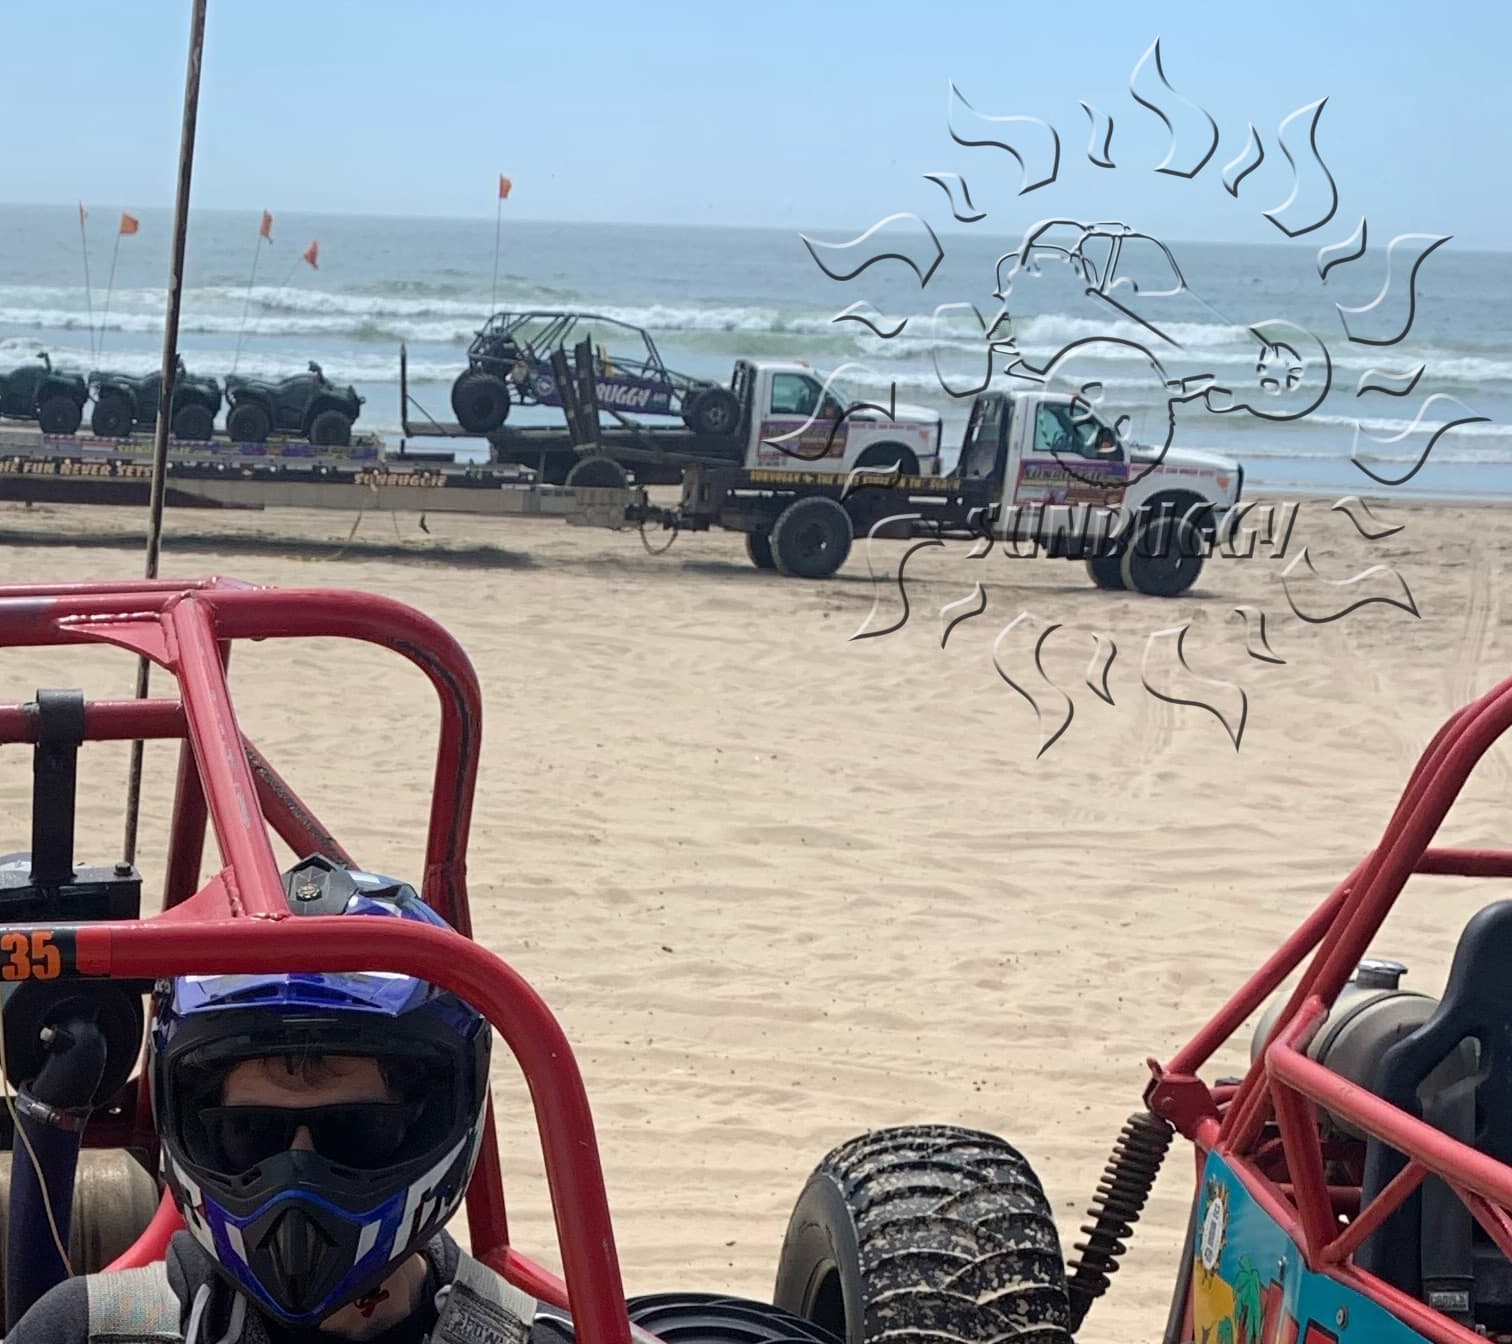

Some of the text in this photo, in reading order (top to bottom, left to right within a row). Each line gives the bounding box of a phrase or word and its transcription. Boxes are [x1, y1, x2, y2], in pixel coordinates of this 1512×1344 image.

[595, 382, 651, 407] BUGGY
[23, 461, 56, 474] FUN
[60, 462, 112, 476] NEVER
